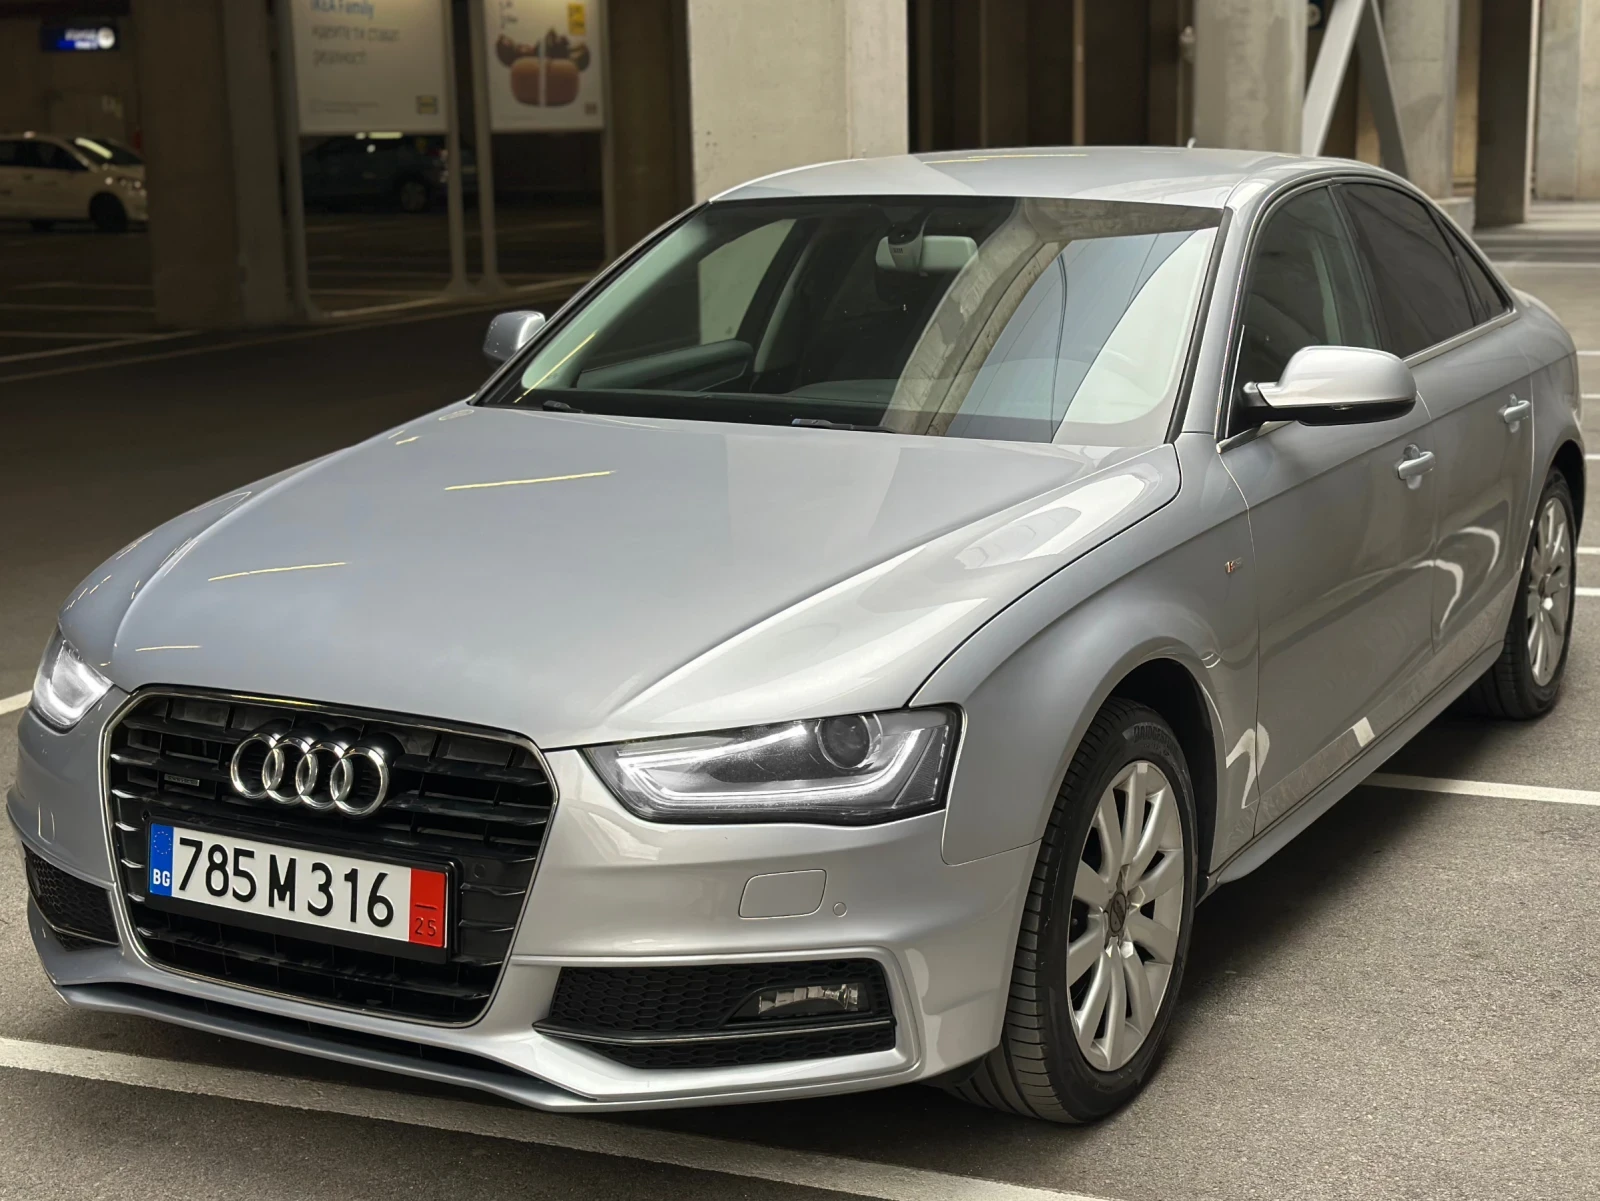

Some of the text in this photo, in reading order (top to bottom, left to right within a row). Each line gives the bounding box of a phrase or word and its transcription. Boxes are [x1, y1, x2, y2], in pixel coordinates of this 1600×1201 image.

[152, 868, 172, 887] BG
[178, 837, 394, 928] 785 M 316
[414, 917, 437, 937] 25
